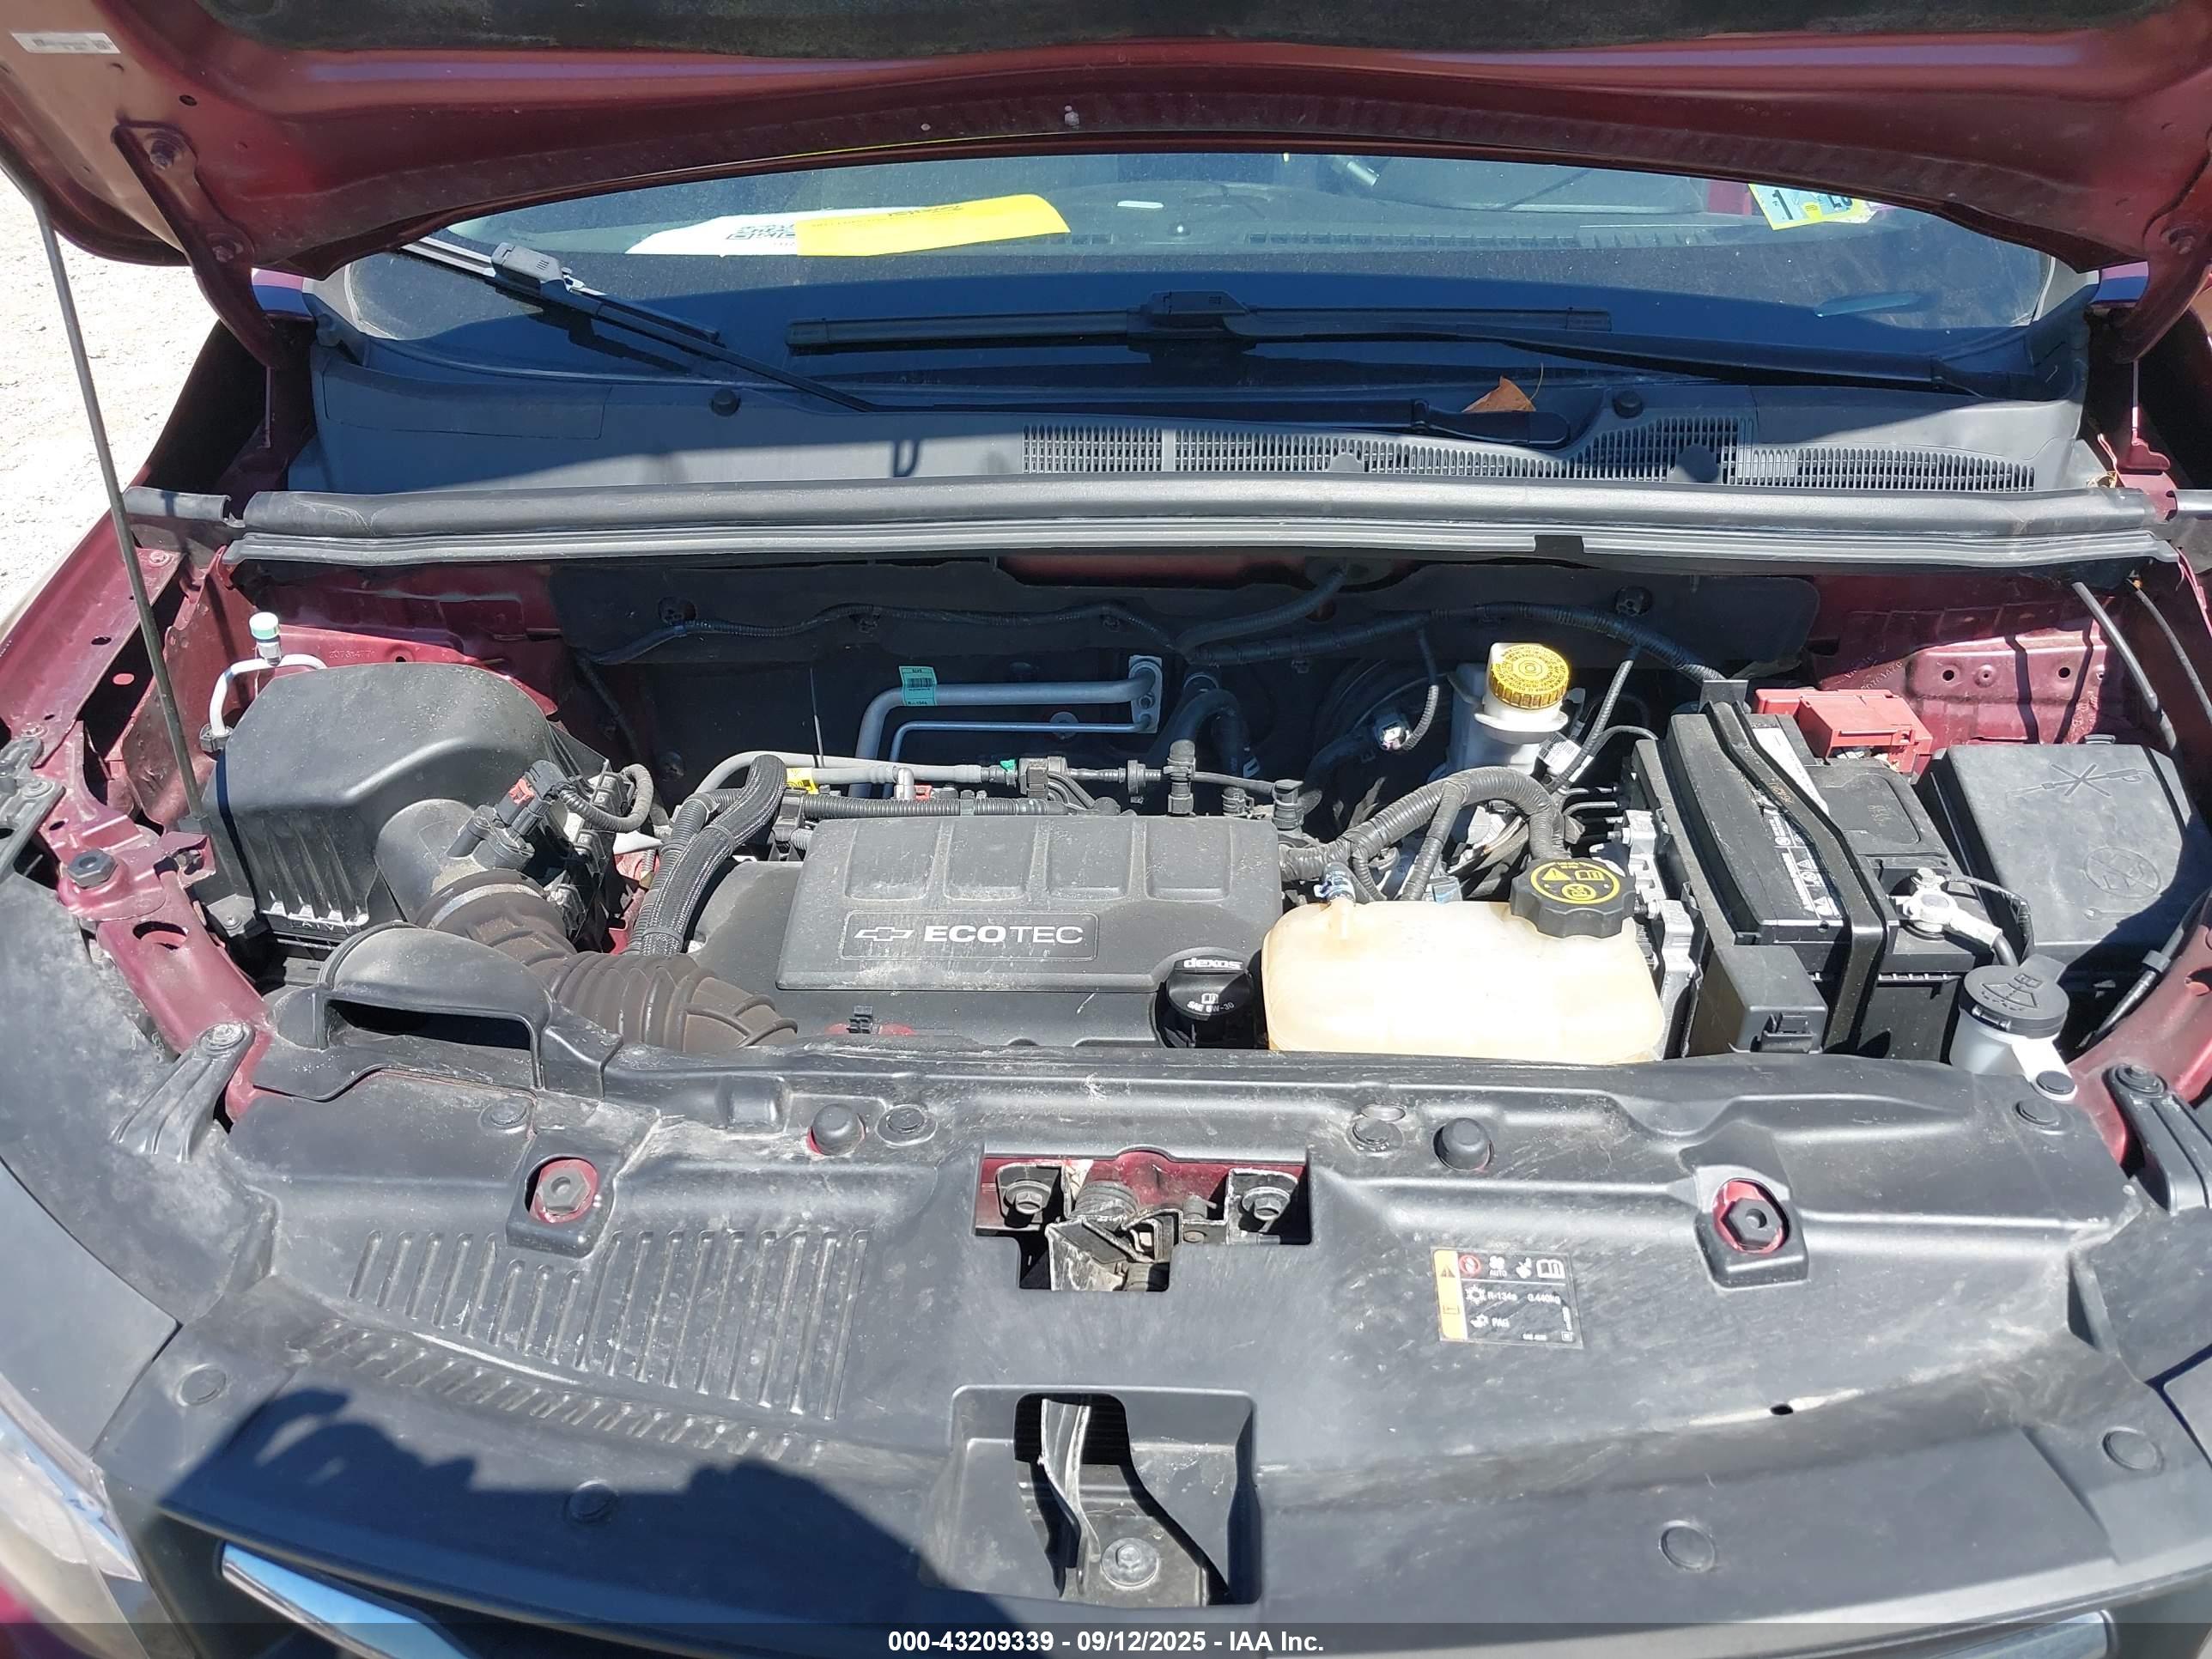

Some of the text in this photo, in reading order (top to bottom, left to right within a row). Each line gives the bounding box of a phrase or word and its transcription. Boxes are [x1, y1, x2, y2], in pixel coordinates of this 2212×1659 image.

[923, 925, 1084, 945] ECOTEC
[1183, 957, 1243, 969] dexos
[1187, 1000, 1235, 1012] SAE 5W-30
[1490, 1269, 1507, 1278] AUTO
[1487, 1291, 1518, 1301] R-134a
